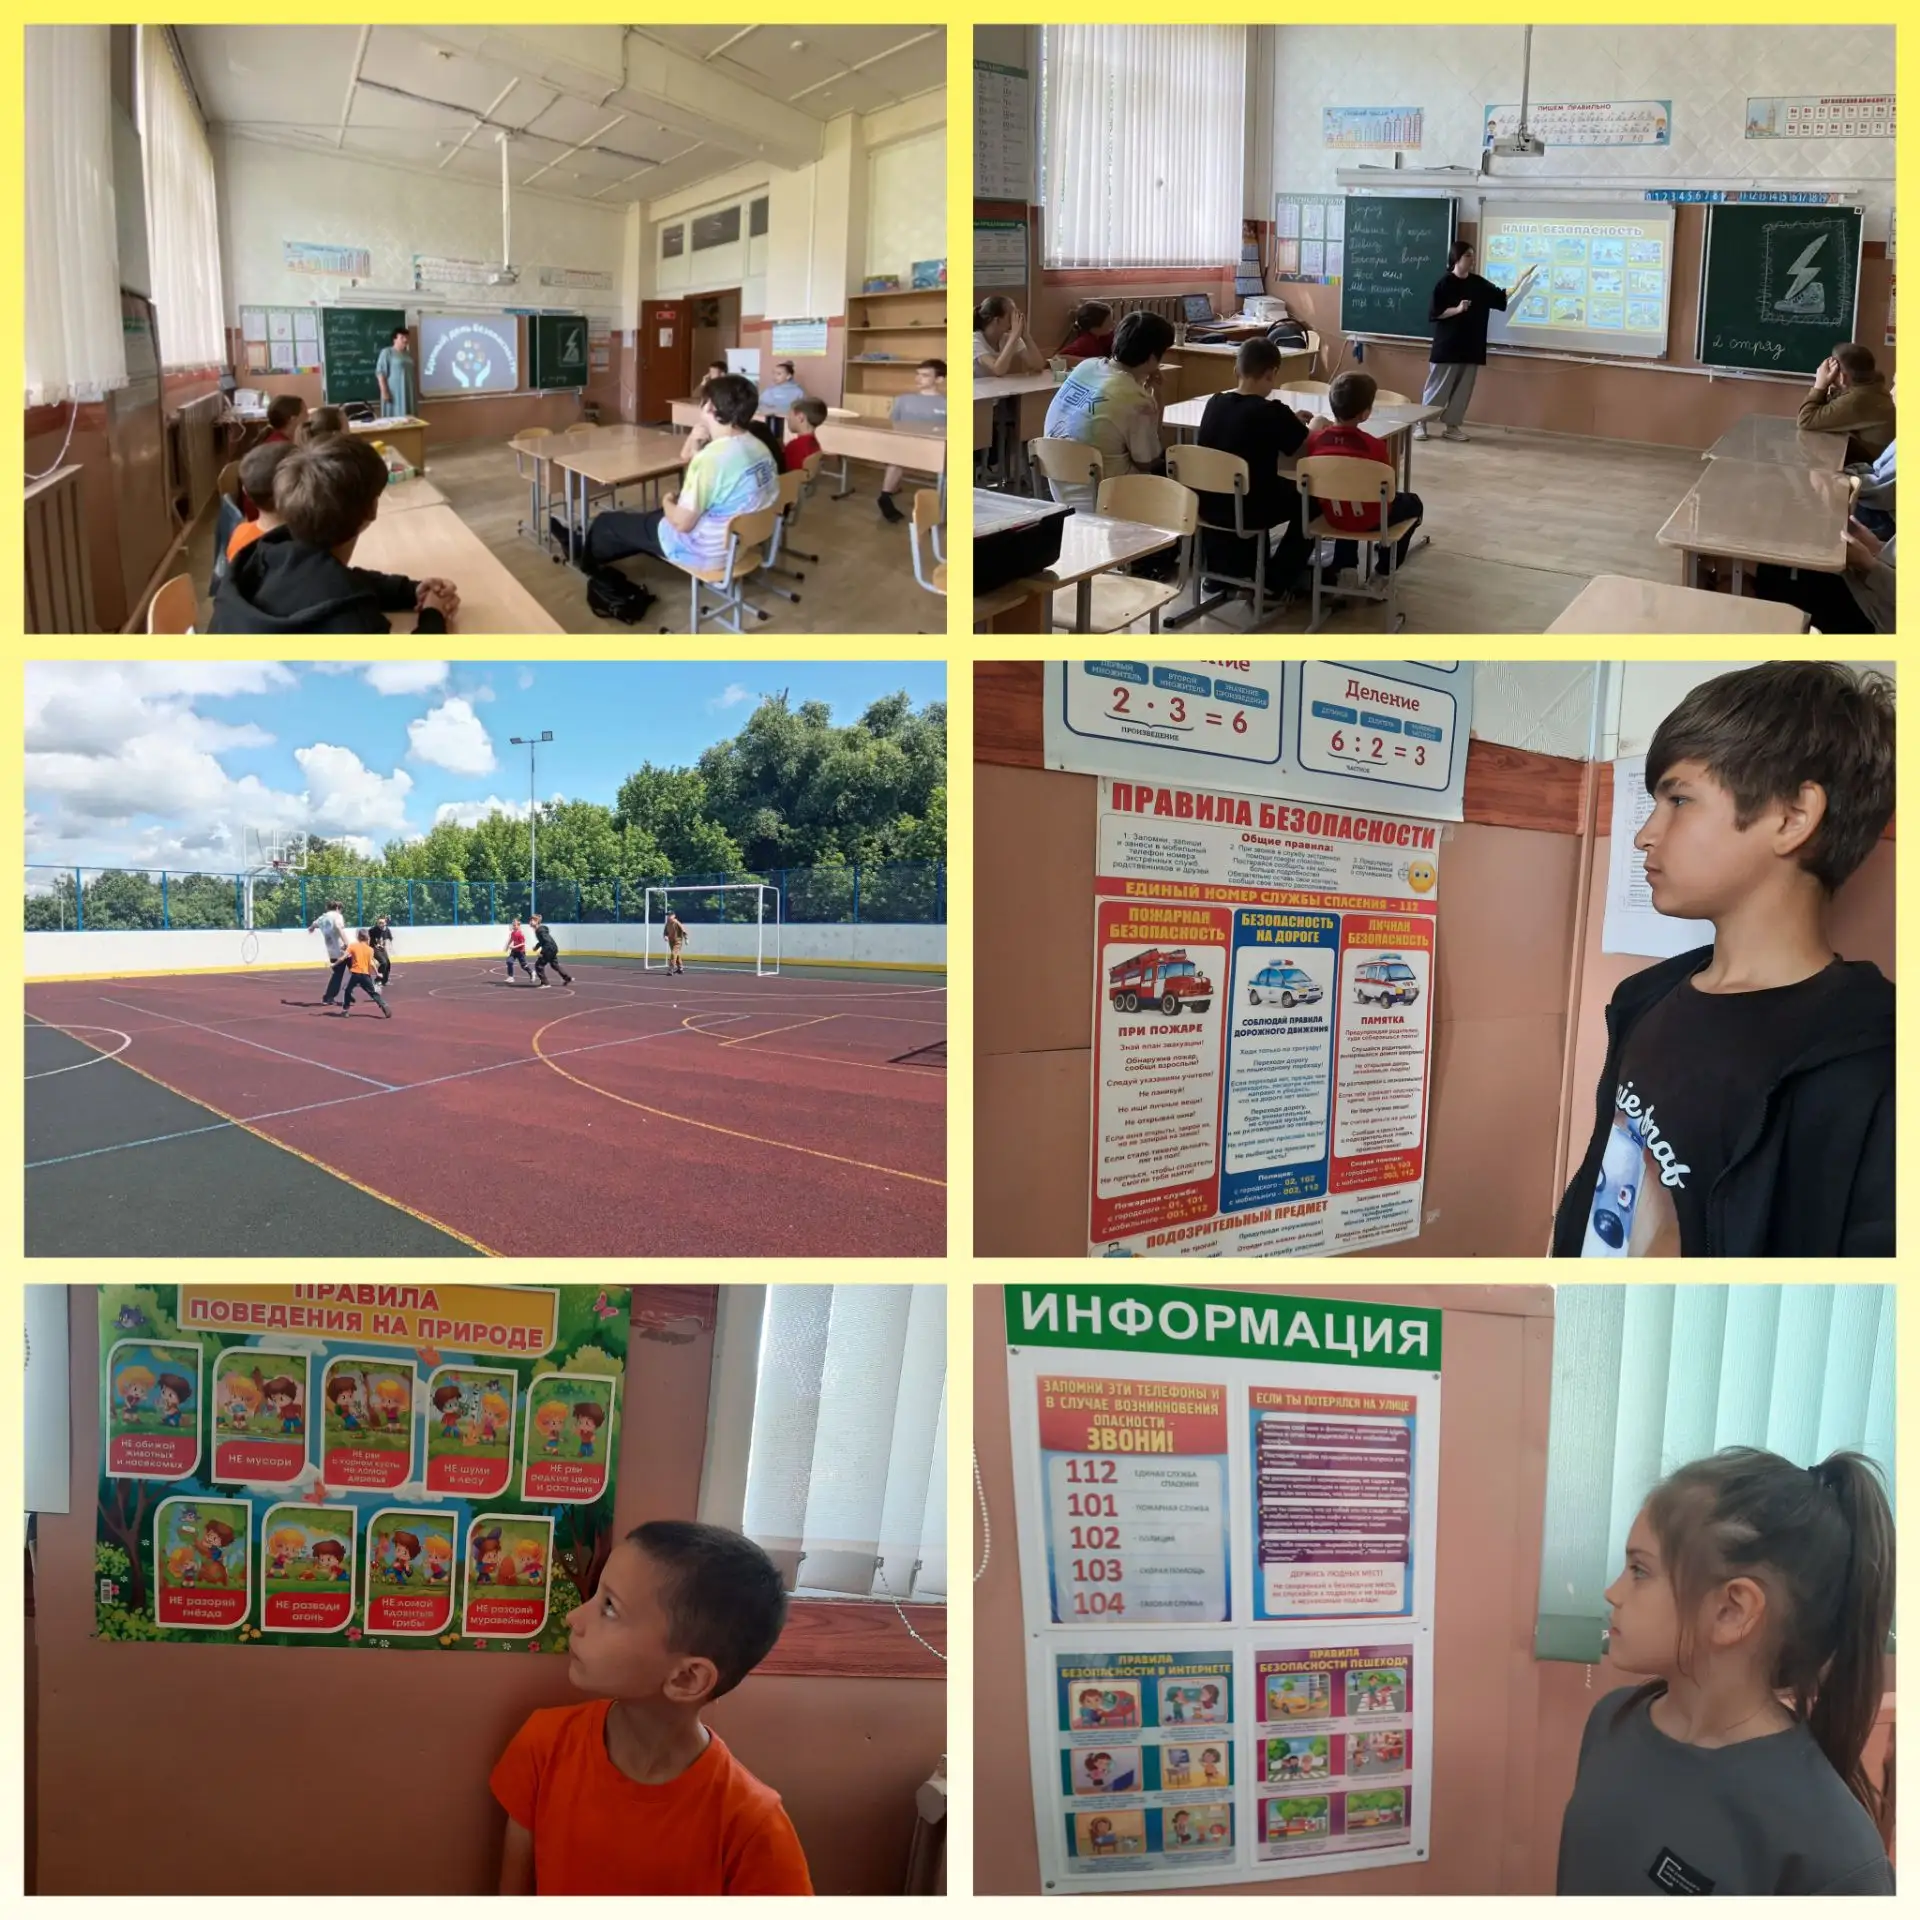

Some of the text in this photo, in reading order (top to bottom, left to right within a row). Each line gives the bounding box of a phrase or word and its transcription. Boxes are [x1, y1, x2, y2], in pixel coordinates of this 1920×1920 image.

[1567, 103, 1612, 111] ПРАВИЛЬНО
[1502, 223, 1643, 237] НАША БЕЗОПАСНОСТЬ
[1713, 335, 1786, 361] 2 отряд
[1091, 665, 1142, 683] МНОЖИТЕЛЬ
[1168, 672, 1198, 685] ВТОРОЙ
[1160, 679, 1206, 694] МНОЖИТЕЛЬ
[1224, 684, 1259, 696] ЗНАЧЕНИЕ
[1216, 689, 1268, 706] ПРОИЗВЕДЕНИЯ
[1345, 678, 1421, 712] Деление
[1112, 686, 1248, 734] 2 3 6
[1121, 725, 1180, 741] ПРОИЗВЕДЕНИЕ
[1331, 730, 1425, 766] 6 2 3
[1112, 782, 1436, 849] ПРАВИЛА БЕЗОПАСНОСТИ
[1124, 841, 1207, 854] занеси мобильный
[1173, 838, 1202, 847] запиши
[1241, 832, 1334, 853] Общие правила:
[1125, 855, 1172, 865] экстренных
[1129, 848, 1196, 860] телефон номера
[1112, 861, 1209, 876] родственников друзей
[1125, 881, 1419, 912] ЕДИНЫЙ НОМЕР СЛУЖБЫ СПАСЕНИЯ 112
[1128, 907, 1211, 924] ПОЖАРНАЯ
[1241, 913, 1334, 929] БЕЗОПАСНОСТЬ
[1109, 923, 1226, 941] БЕЗОПАСНОСТЬ
[1368, 919, 1411, 932] ЛИЧНАЯ
[1256, 929, 1320, 944] НА ДОРОГЕ
[1348, 932, 1430, 947] БЕЗОПАСНОСТЬ
[1242, 1015, 1323, 1027] СОБЛЮДАЙ ПРАВИЛА
[1361, 1015, 1405, 1025] ПАМЯТКА
[1118, 1023, 1203, 1037] ПРИ ПОЖАРЕ
[1233, 1025, 1329, 1038] ДОРОЖНОГО ДВИЖЕНИЯ
[1119, 1042, 1161, 1051] Знай план
[1124, 1059, 1199, 1072] сообщи взрослым!
[1125, 1055, 1171, 1065] Обнаружив
[1106, 1078, 1138, 1088] Следуй
[1138, 1087, 1185, 1098] Не паникуй!
[1149, 1097, 1203, 1110] личные вещи!
[1137, 1114, 1175, 1125] открывай
[1105, 1135, 1124, 1143] Если
[1104, 1146, 1179, 1164] Если стало тяжело
[1150, 1165, 1175, 1175] чтобы
[1151, 1174, 1169, 1182] тебя
[1114, 1188, 1199, 1210] Пожарная служба:
[1114, 1196, 1203, 1221] городского 01, 101
[1108, 1204, 1208, 1233] мобильного 112
[1146, 1200, 1329, 1249] ПОДОЗРИТЕЛЬНЫЙ ПРЕДМЕТ
[294, 1284, 439, 1312] ПРАВИЛА
[190, 1300, 545, 1351] ПОВЕДЕНИЯ НА ПРИРОДЕ
[1021, 1290, 1429, 1359] ИНФОРМАЦИЯ
[1043, 1380, 1220, 1400] ЗАПОМНИ ЭТИ ТЕЛЕФОНЫ И
[1045, 1397, 1219, 1416] В СЛУЧАЕ ВОЗНИКНОВЕНИЯ
[1256, 1392, 1410, 1412] ЕСЛИ ТЫ ПОТЕРЯЛСЯ НА УЛИЦЕ
[1093, 1414, 1165, 1428] ОПАСНОСТИ
[121, 1440, 176, 1450] НЕ обижай
[1087, 1427, 1174, 1453] ЗВОНИ!
[126, 1450, 174, 1459] животных
[228, 1454, 292, 1467] НЕ мусори
[364, 1452, 380, 1460] рви
[125, 1459, 184, 1469] насекомых
[444, 1464, 491, 1476] НЕ шуми
[550, 1464, 583, 1475] НЕ рви
[1065, 1459, 1118, 1484] 112
[459, 1476, 484, 1486] лесу
[530, 1474, 600, 1486] редкие цветы
[546, 1484, 593, 1494] растения
[1067, 1492, 1119, 1518] 101
[1070, 1526, 1121, 1550] 102
[1071, 1558, 1123, 1582] 103
[169, 1596, 236, 1608] НЕ разоряй
[275, 1600, 341, 1612] НЕ разводи
[381, 1598, 433, 1608] НЕ ломай
[1073, 1591, 1126, 1615] 104
[182, 1608, 222, 1618] гнёзда
[383, 1609, 434, 1618] ядовитые
[475, 1604, 534, 1615] НЕ разоряй
[292, 1612, 324, 1622] огонь
[392, 1618, 426, 1629] грибы
[470, 1616, 538, 1627] муравейники
[1118, 1654, 1174, 1665] ПРАВИЛА
[1309, 1647, 1360, 1659] ПРАВИЛА
[1061, 1663, 1232, 1679] БЕЗОПАСНОСТИ В ИНТЕРНЕТЕ
[1259, 1656, 1408, 1673] БЕЗОПАСНОСТИ ПЕШЕХОДА
